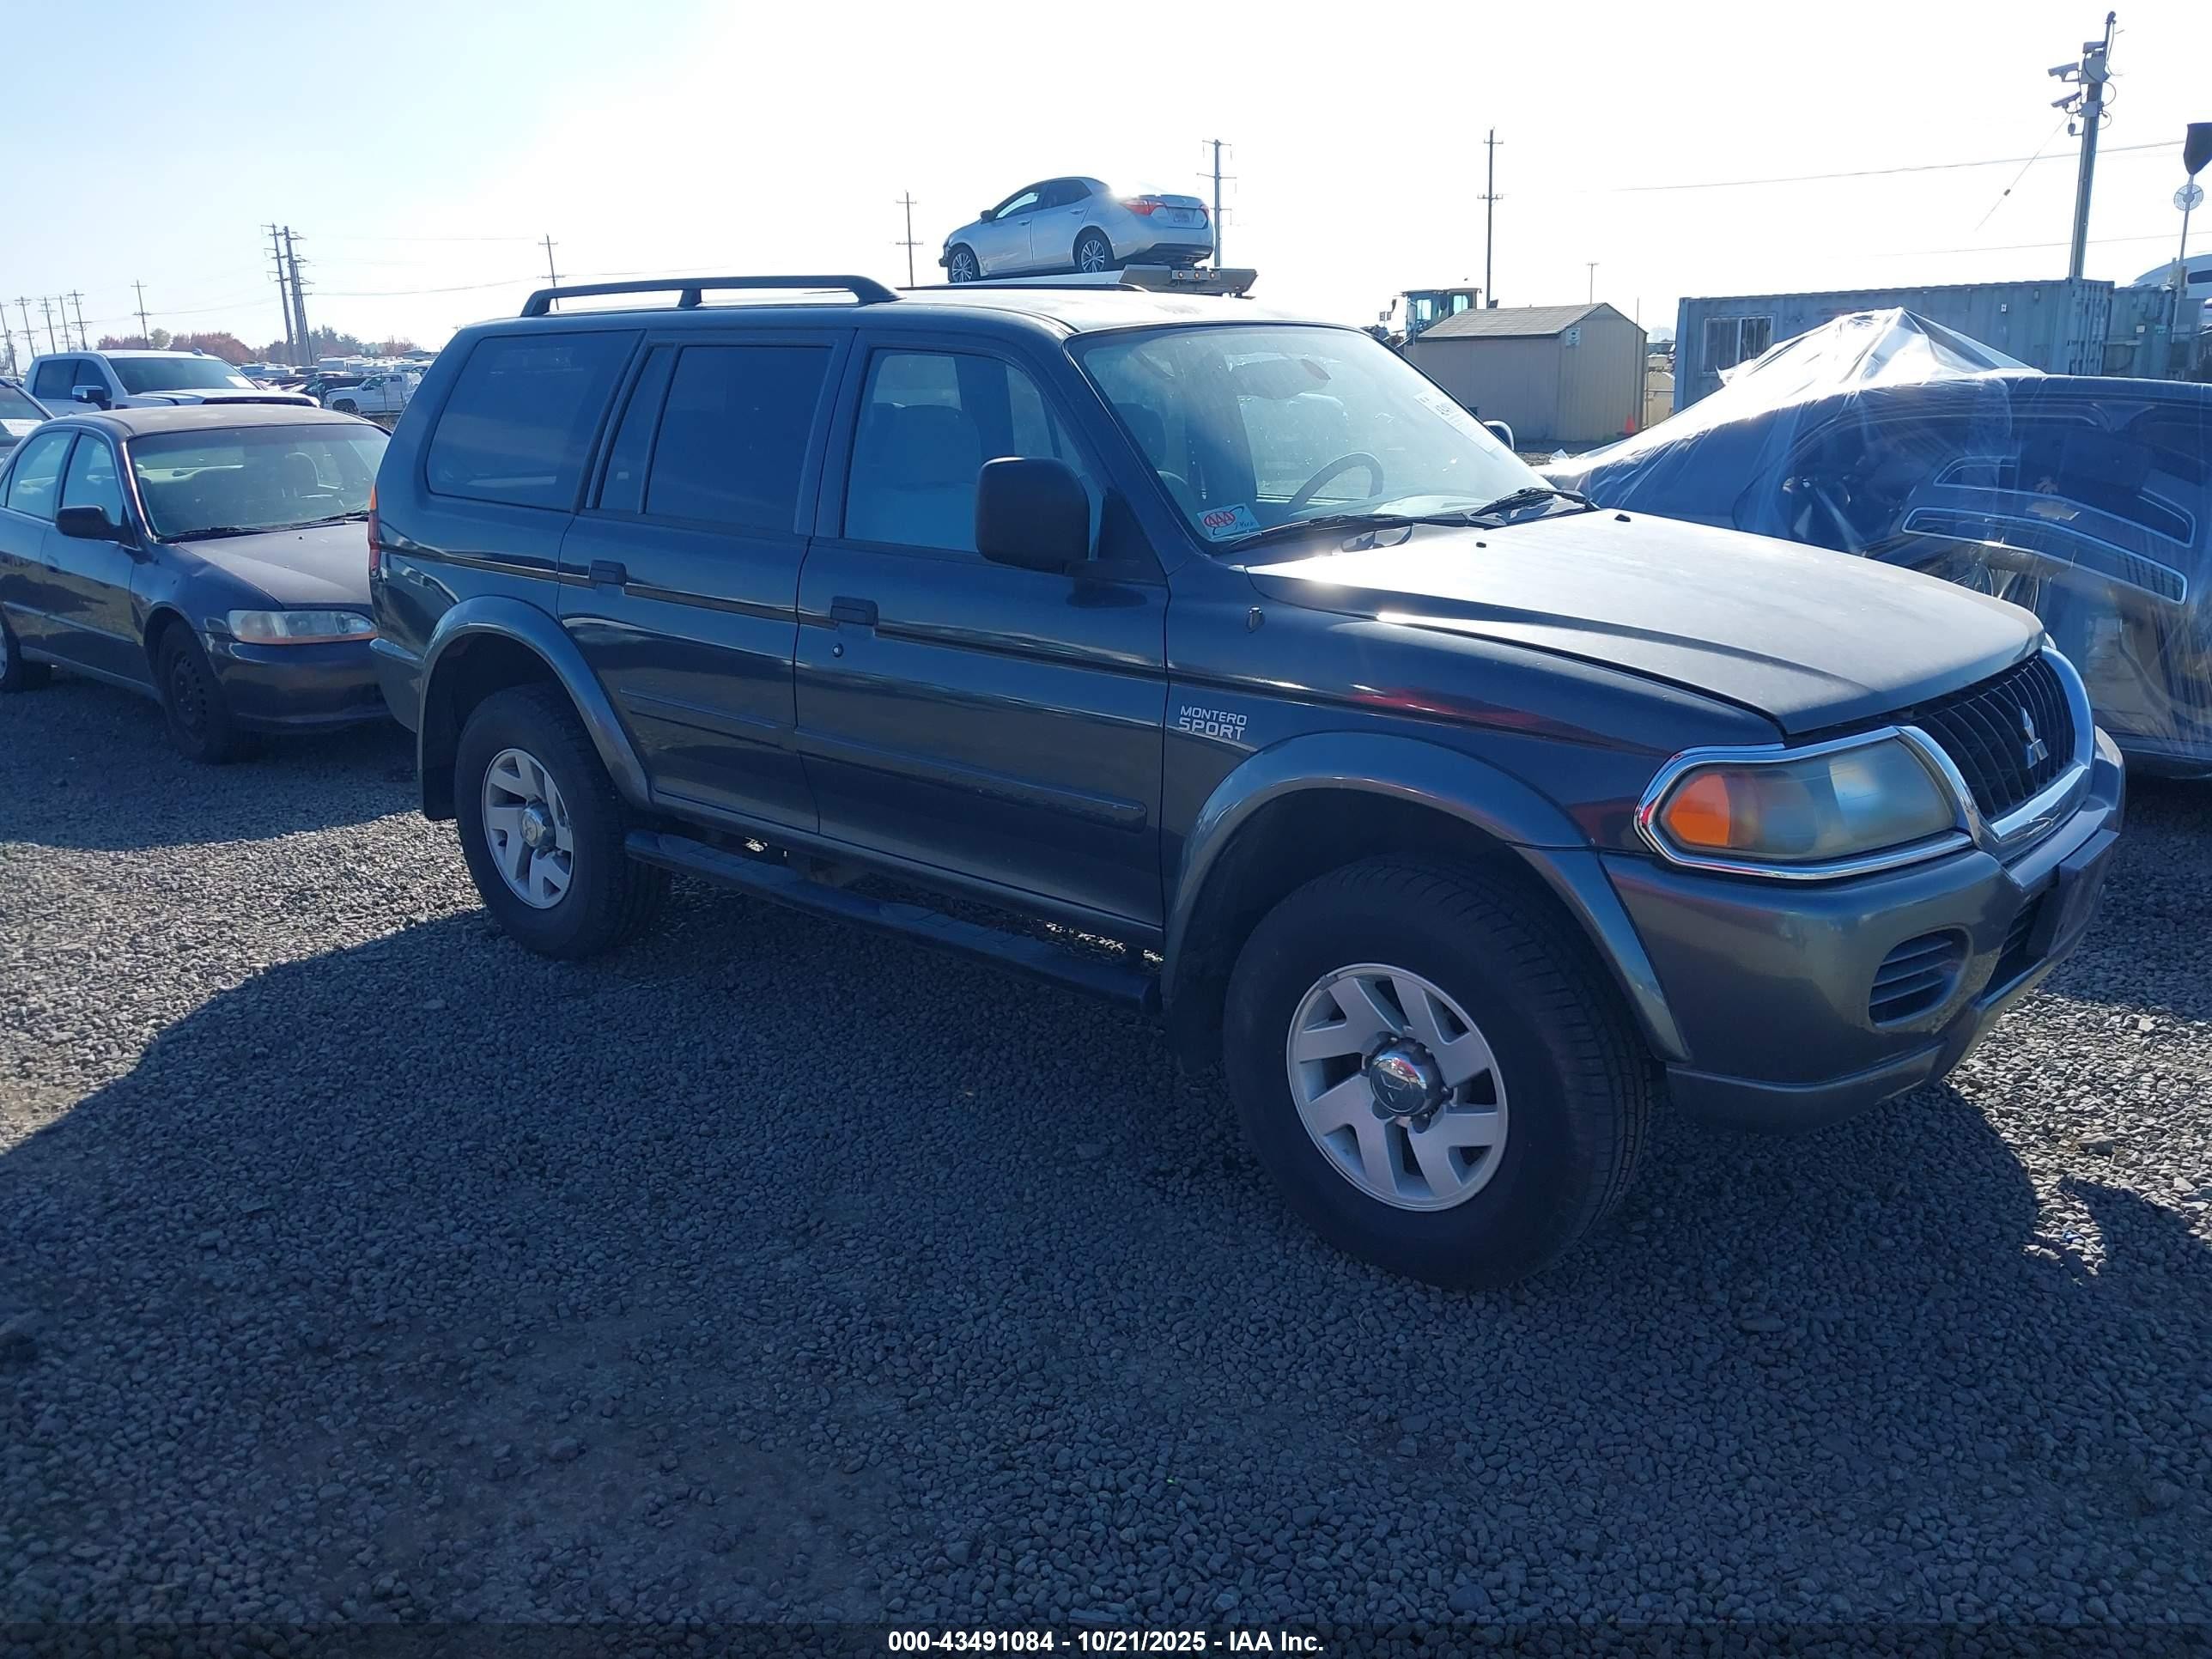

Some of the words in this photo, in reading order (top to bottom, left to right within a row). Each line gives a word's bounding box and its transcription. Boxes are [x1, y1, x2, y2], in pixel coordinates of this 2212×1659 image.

[1207, 511, 1234, 526] AAA
[1180, 705, 1248, 726] MONTERO
[1178, 717, 1245, 740] SPORT
